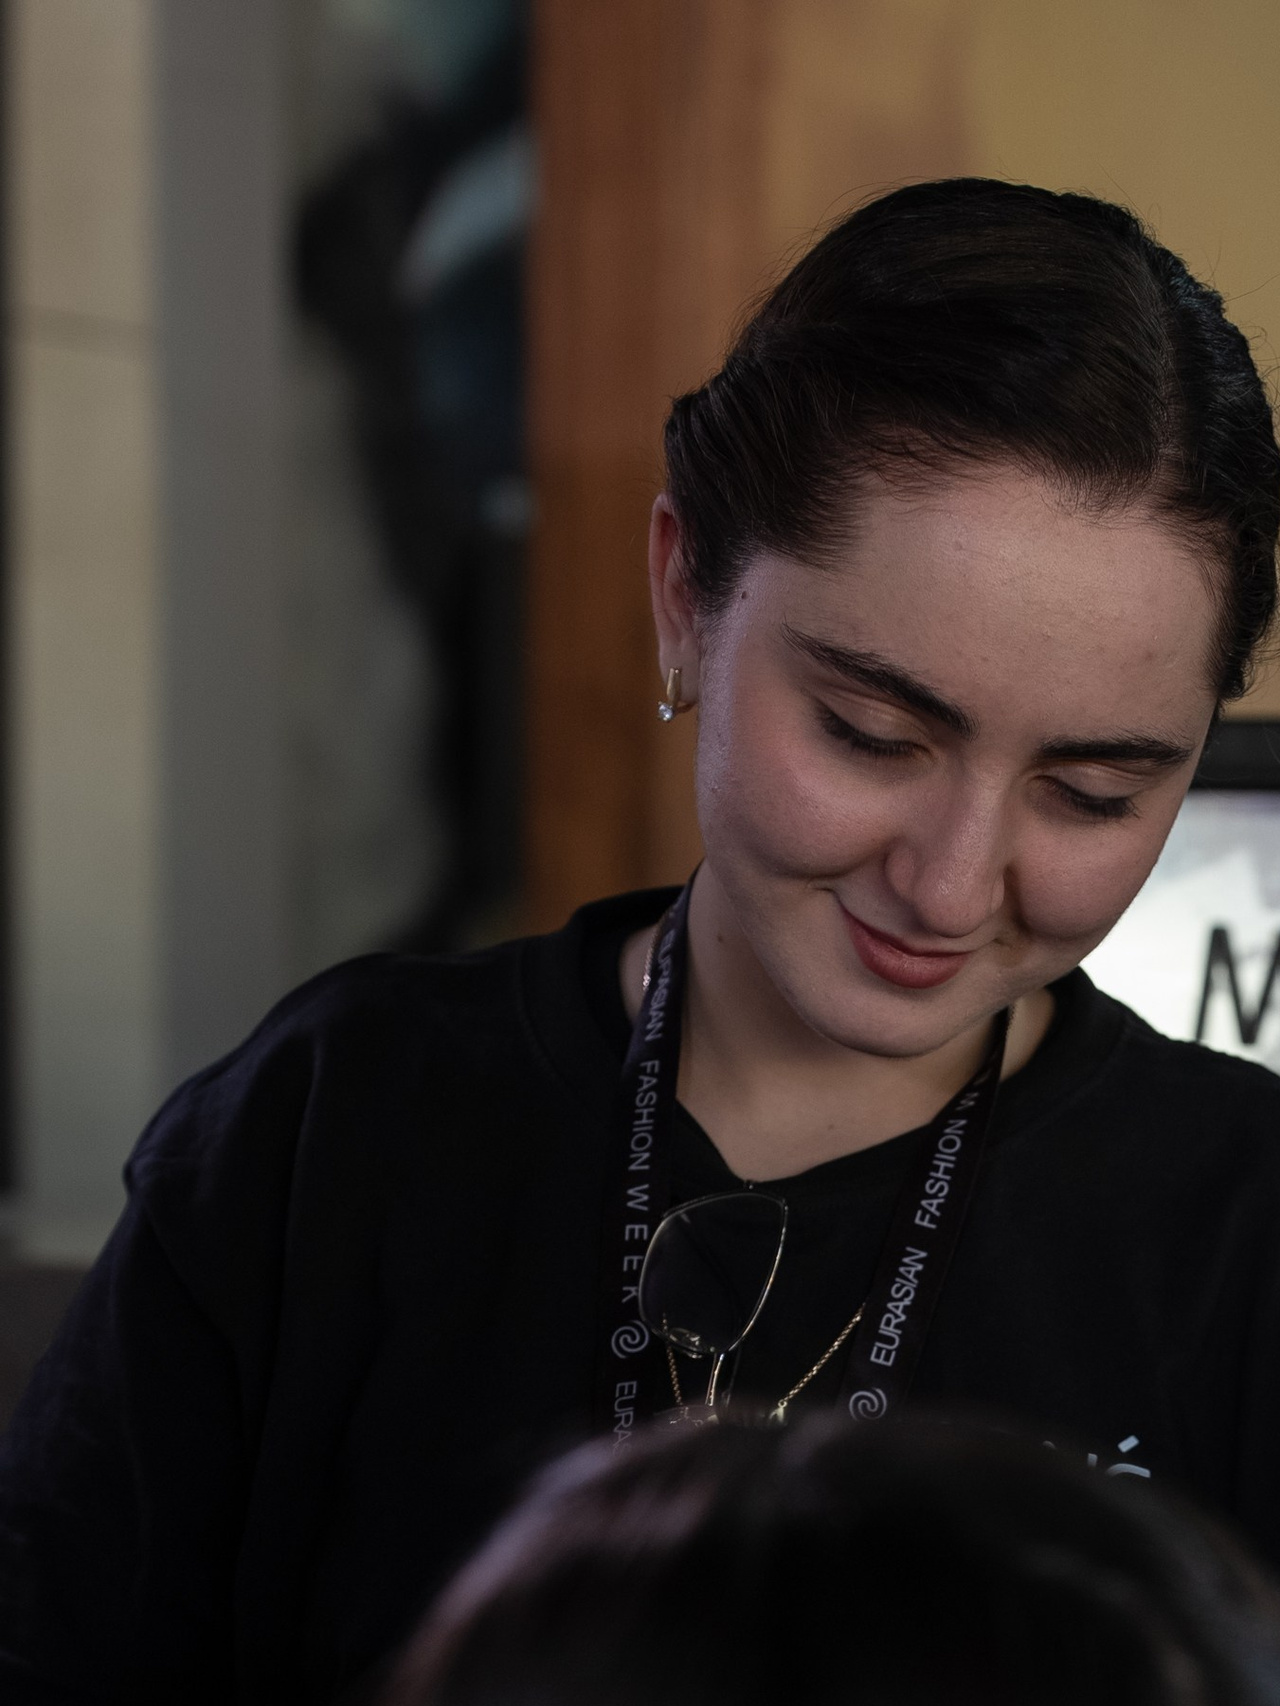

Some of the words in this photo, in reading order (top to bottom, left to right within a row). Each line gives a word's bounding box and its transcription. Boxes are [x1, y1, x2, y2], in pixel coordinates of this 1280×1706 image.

[628, 1058, 660, 1172] FASHION
[870, 1247, 929, 1368] EURASIAN
[915, 1118, 968, 1230] FASHION
